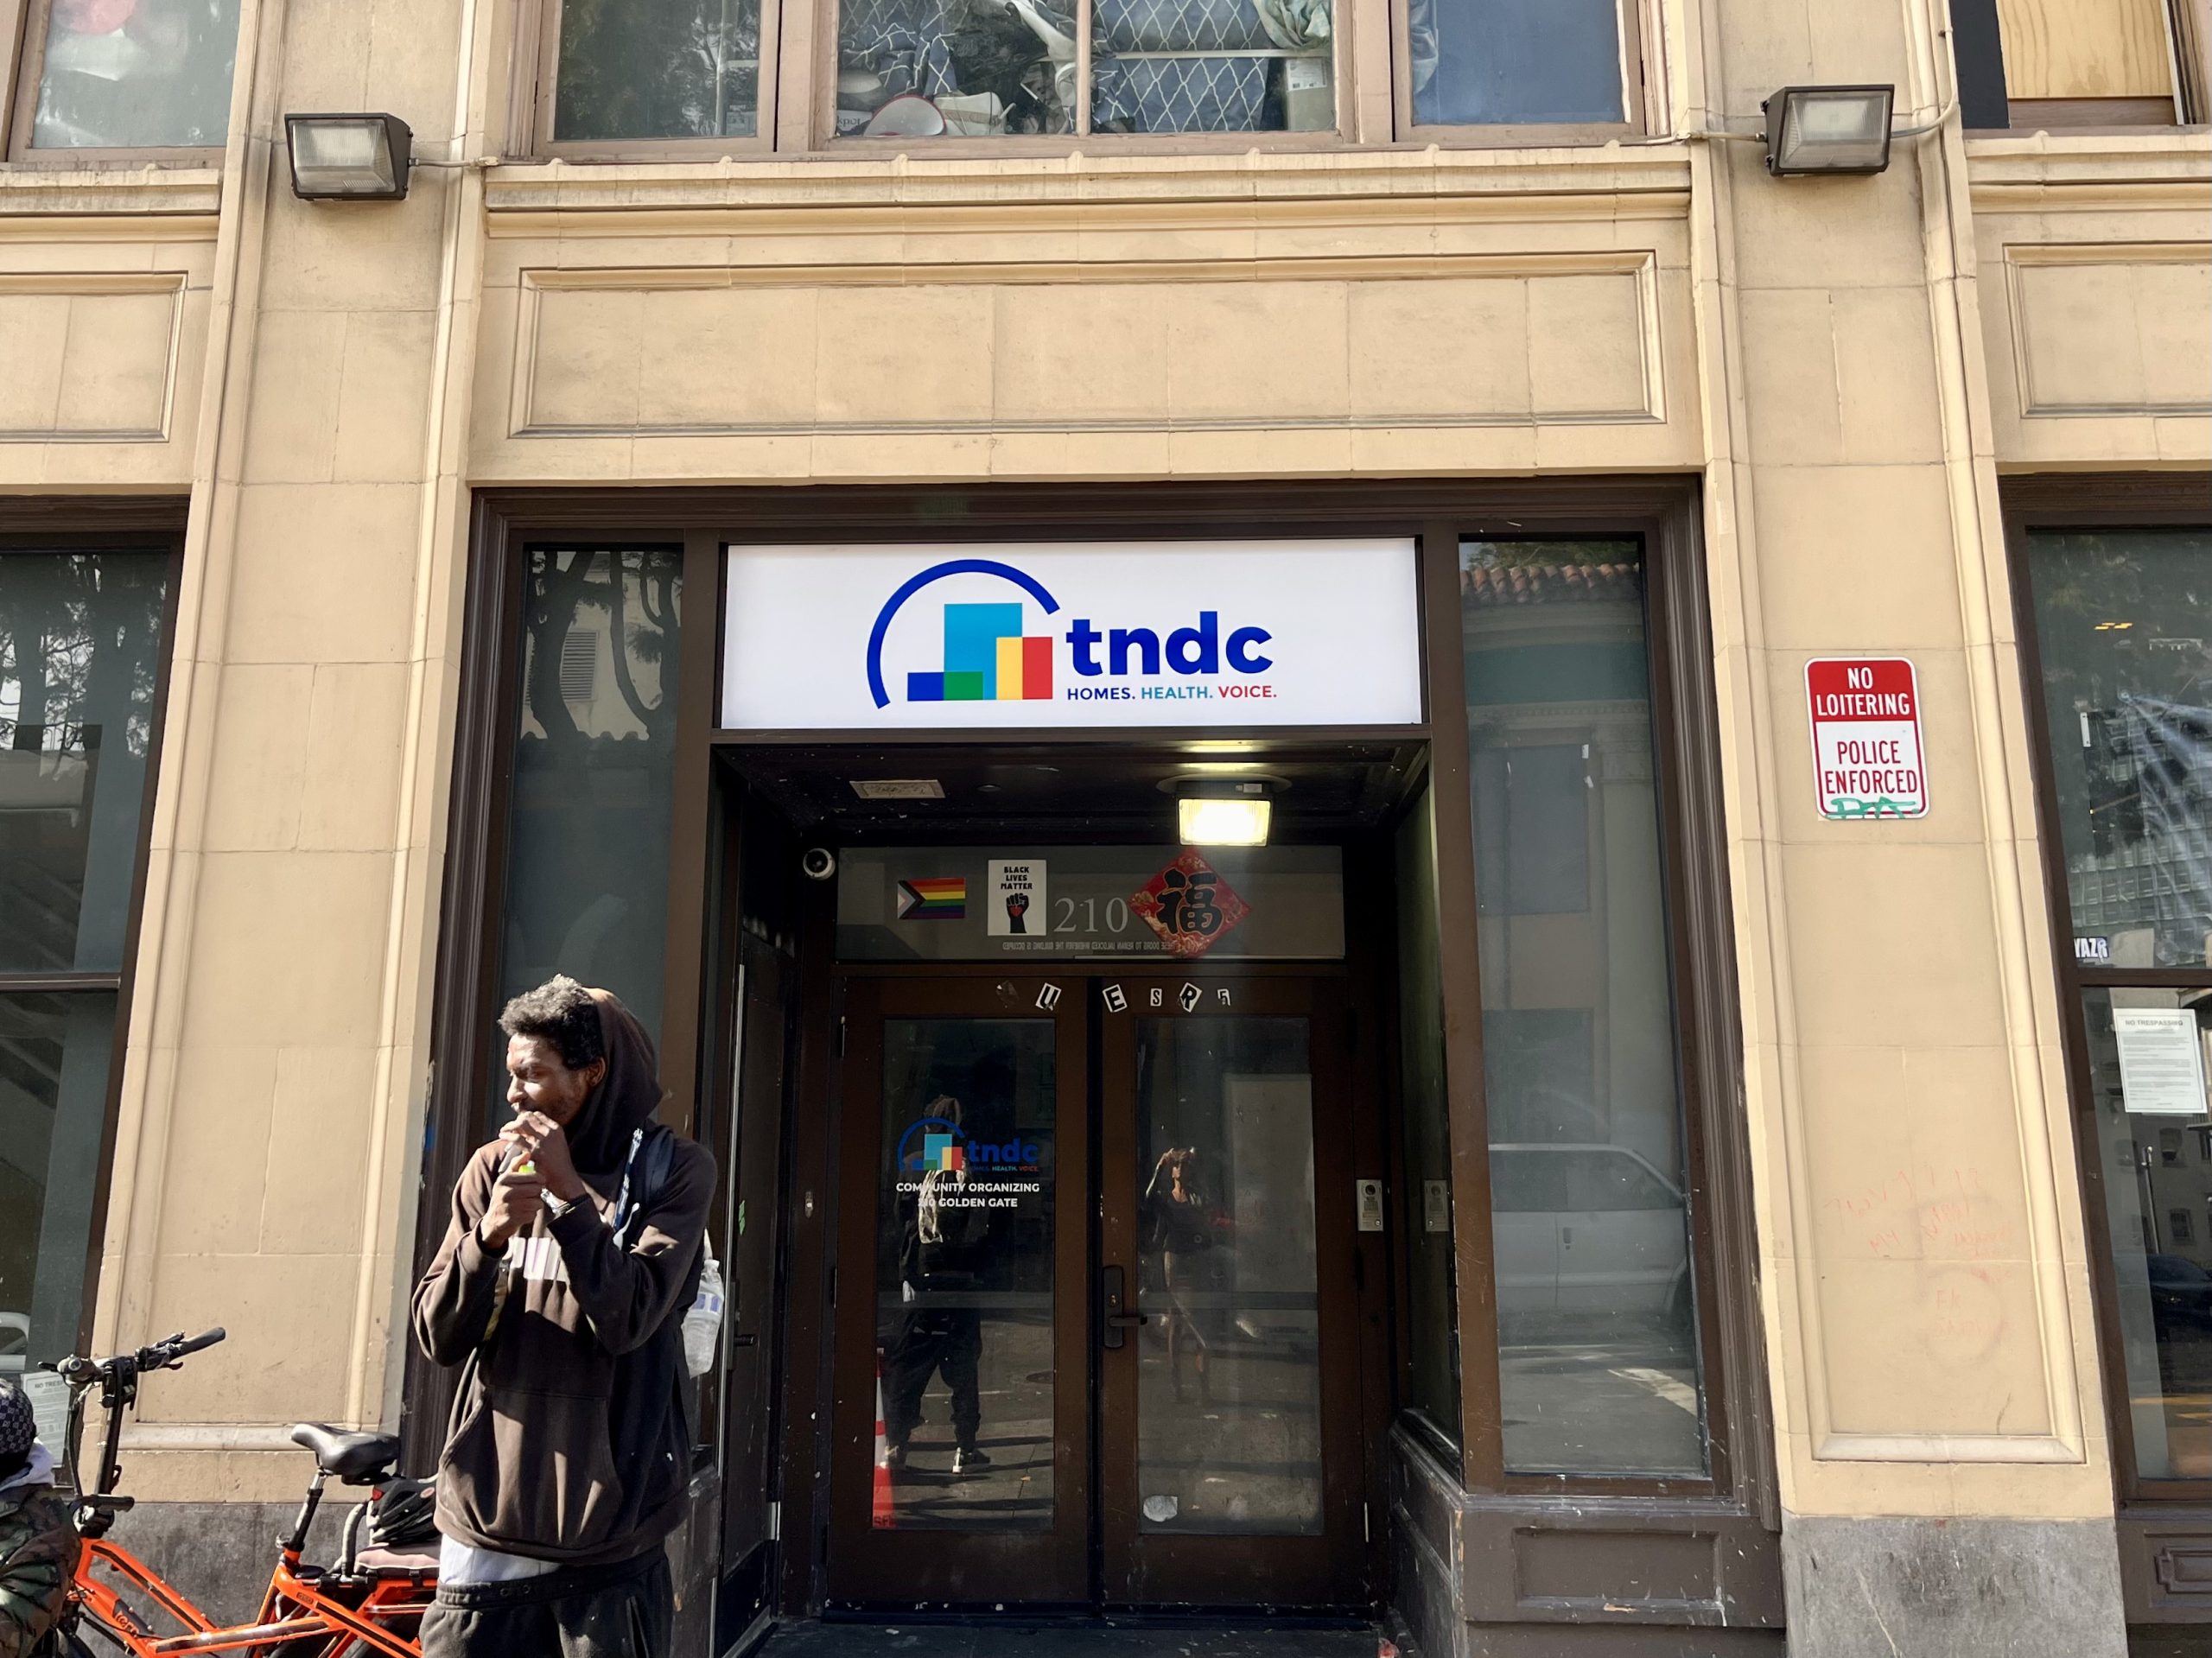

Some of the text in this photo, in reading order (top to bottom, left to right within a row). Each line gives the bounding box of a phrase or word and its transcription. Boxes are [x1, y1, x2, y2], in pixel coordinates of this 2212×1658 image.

[1066, 610, 1274, 677] tndc
[1847, 667, 1874, 689] NO
[1067, 685, 1278, 701] HOMES. HEALTH. VOICE.
[1816, 694, 1910, 716] LOITERING
[1837, 740, 1902, 765] POLICE
[1825, 770, 1918, 794] ENFORCED
[1155, 867, 1224, 937] 福
[1053, 897, 1129, 933] 210
[968, 1138, 1039, 1163] tndc
[968, 1183, 1040, 1193] ORGANIZING
[938, 1197, 986, 1208] GOLDEN
[988, 1197, 1019, 1208] GATE
